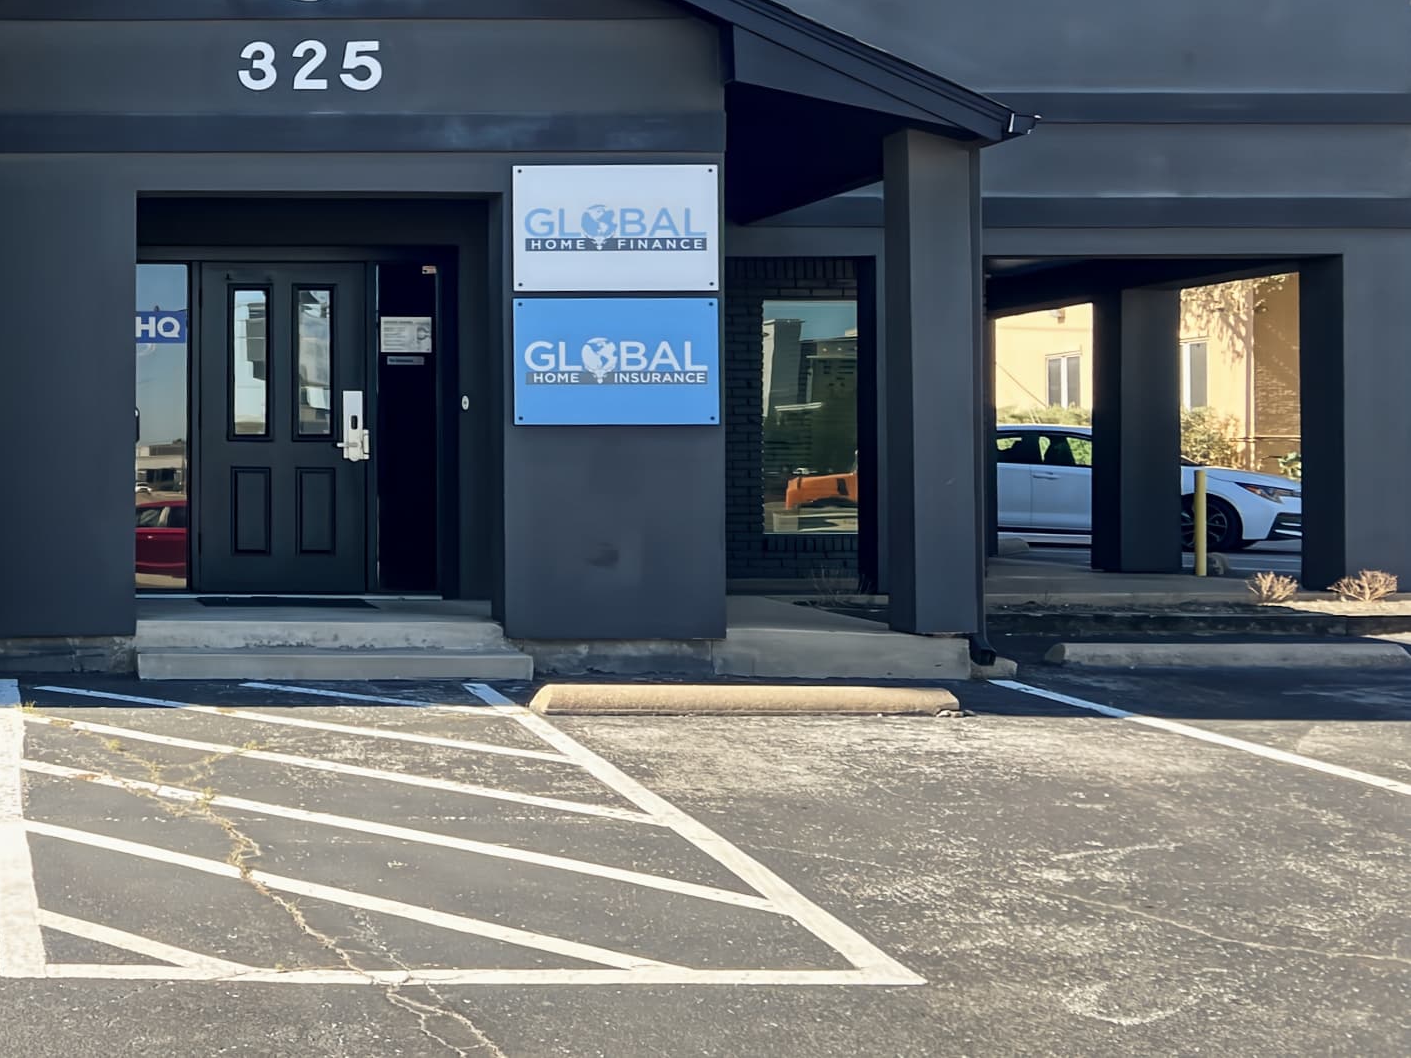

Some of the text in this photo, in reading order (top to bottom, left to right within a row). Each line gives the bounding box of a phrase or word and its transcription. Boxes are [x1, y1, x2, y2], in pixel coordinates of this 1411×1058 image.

[238, 40, 382, 90] 325
[525, 205, 707, 238] GLOBAL
[532, 239, 704, 250] HOME FINANCE
[135, 316, 181, 338] HQ
[525, 337, 708, 373] GLOBAL
[533, 372, 706, 383] HOME INSURANCE
